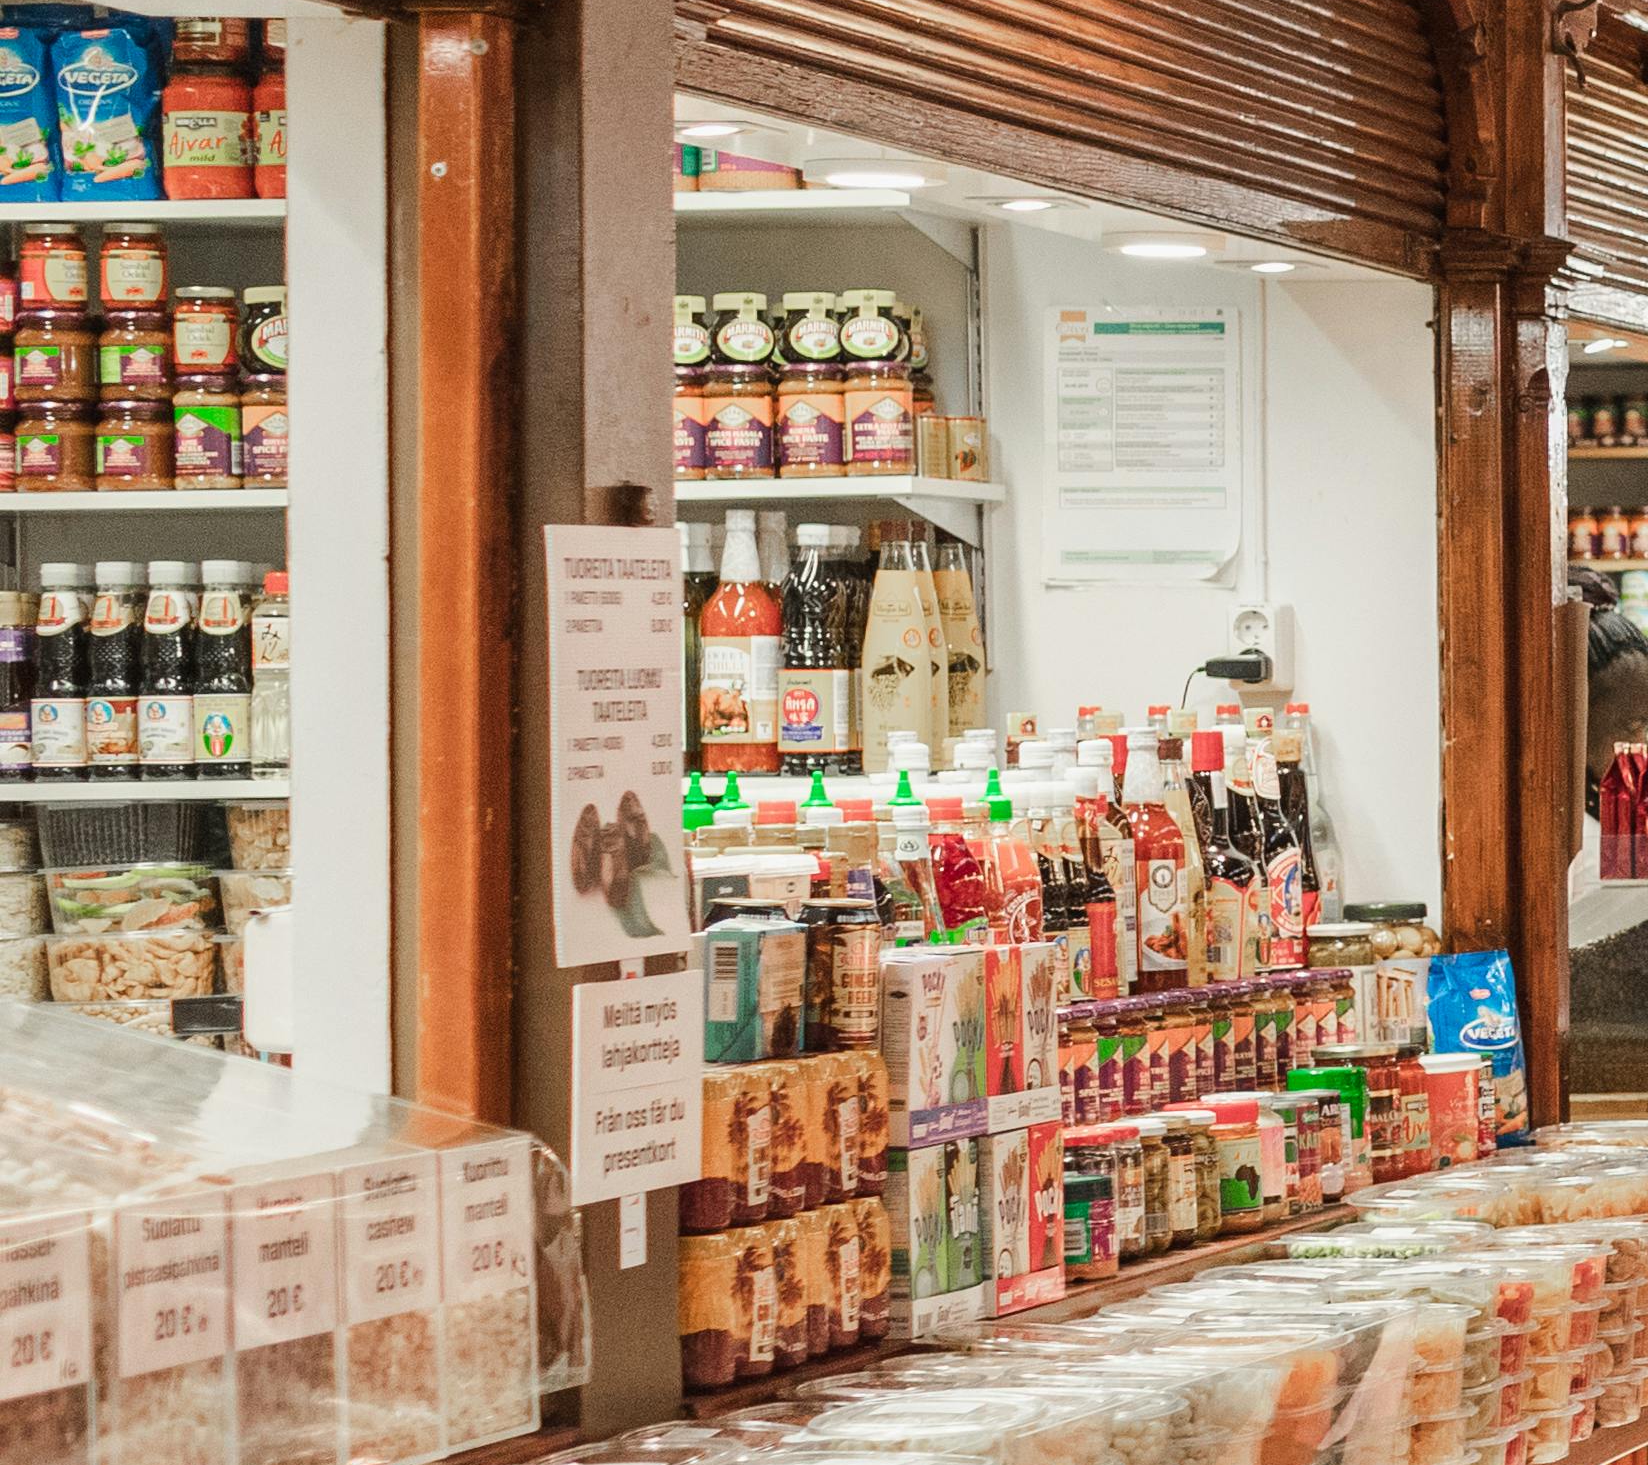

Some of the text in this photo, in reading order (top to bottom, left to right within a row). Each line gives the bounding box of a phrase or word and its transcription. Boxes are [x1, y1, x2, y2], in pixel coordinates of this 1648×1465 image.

[64, 70, 130, 85] VEGETA
[169, 131, 229, 158] Ajvar
[603, 997, 678, 1030] Meiltä myös
[601, 1035, 681, 1074] lahjakortteja
[594, 1096, 687, 1136] Från oss får du
[603, 1138, 677, 1179] presentkort
[259, 1230, 309, 1264] manteli
[472, 1243, 491, 1272] 20
[375, 1262, 395, 1294] 20
[267, 1285, 289, 1319] 20
[154, 1307, 178, 1342] 20
[11, 1333, 35, 1368] 20
